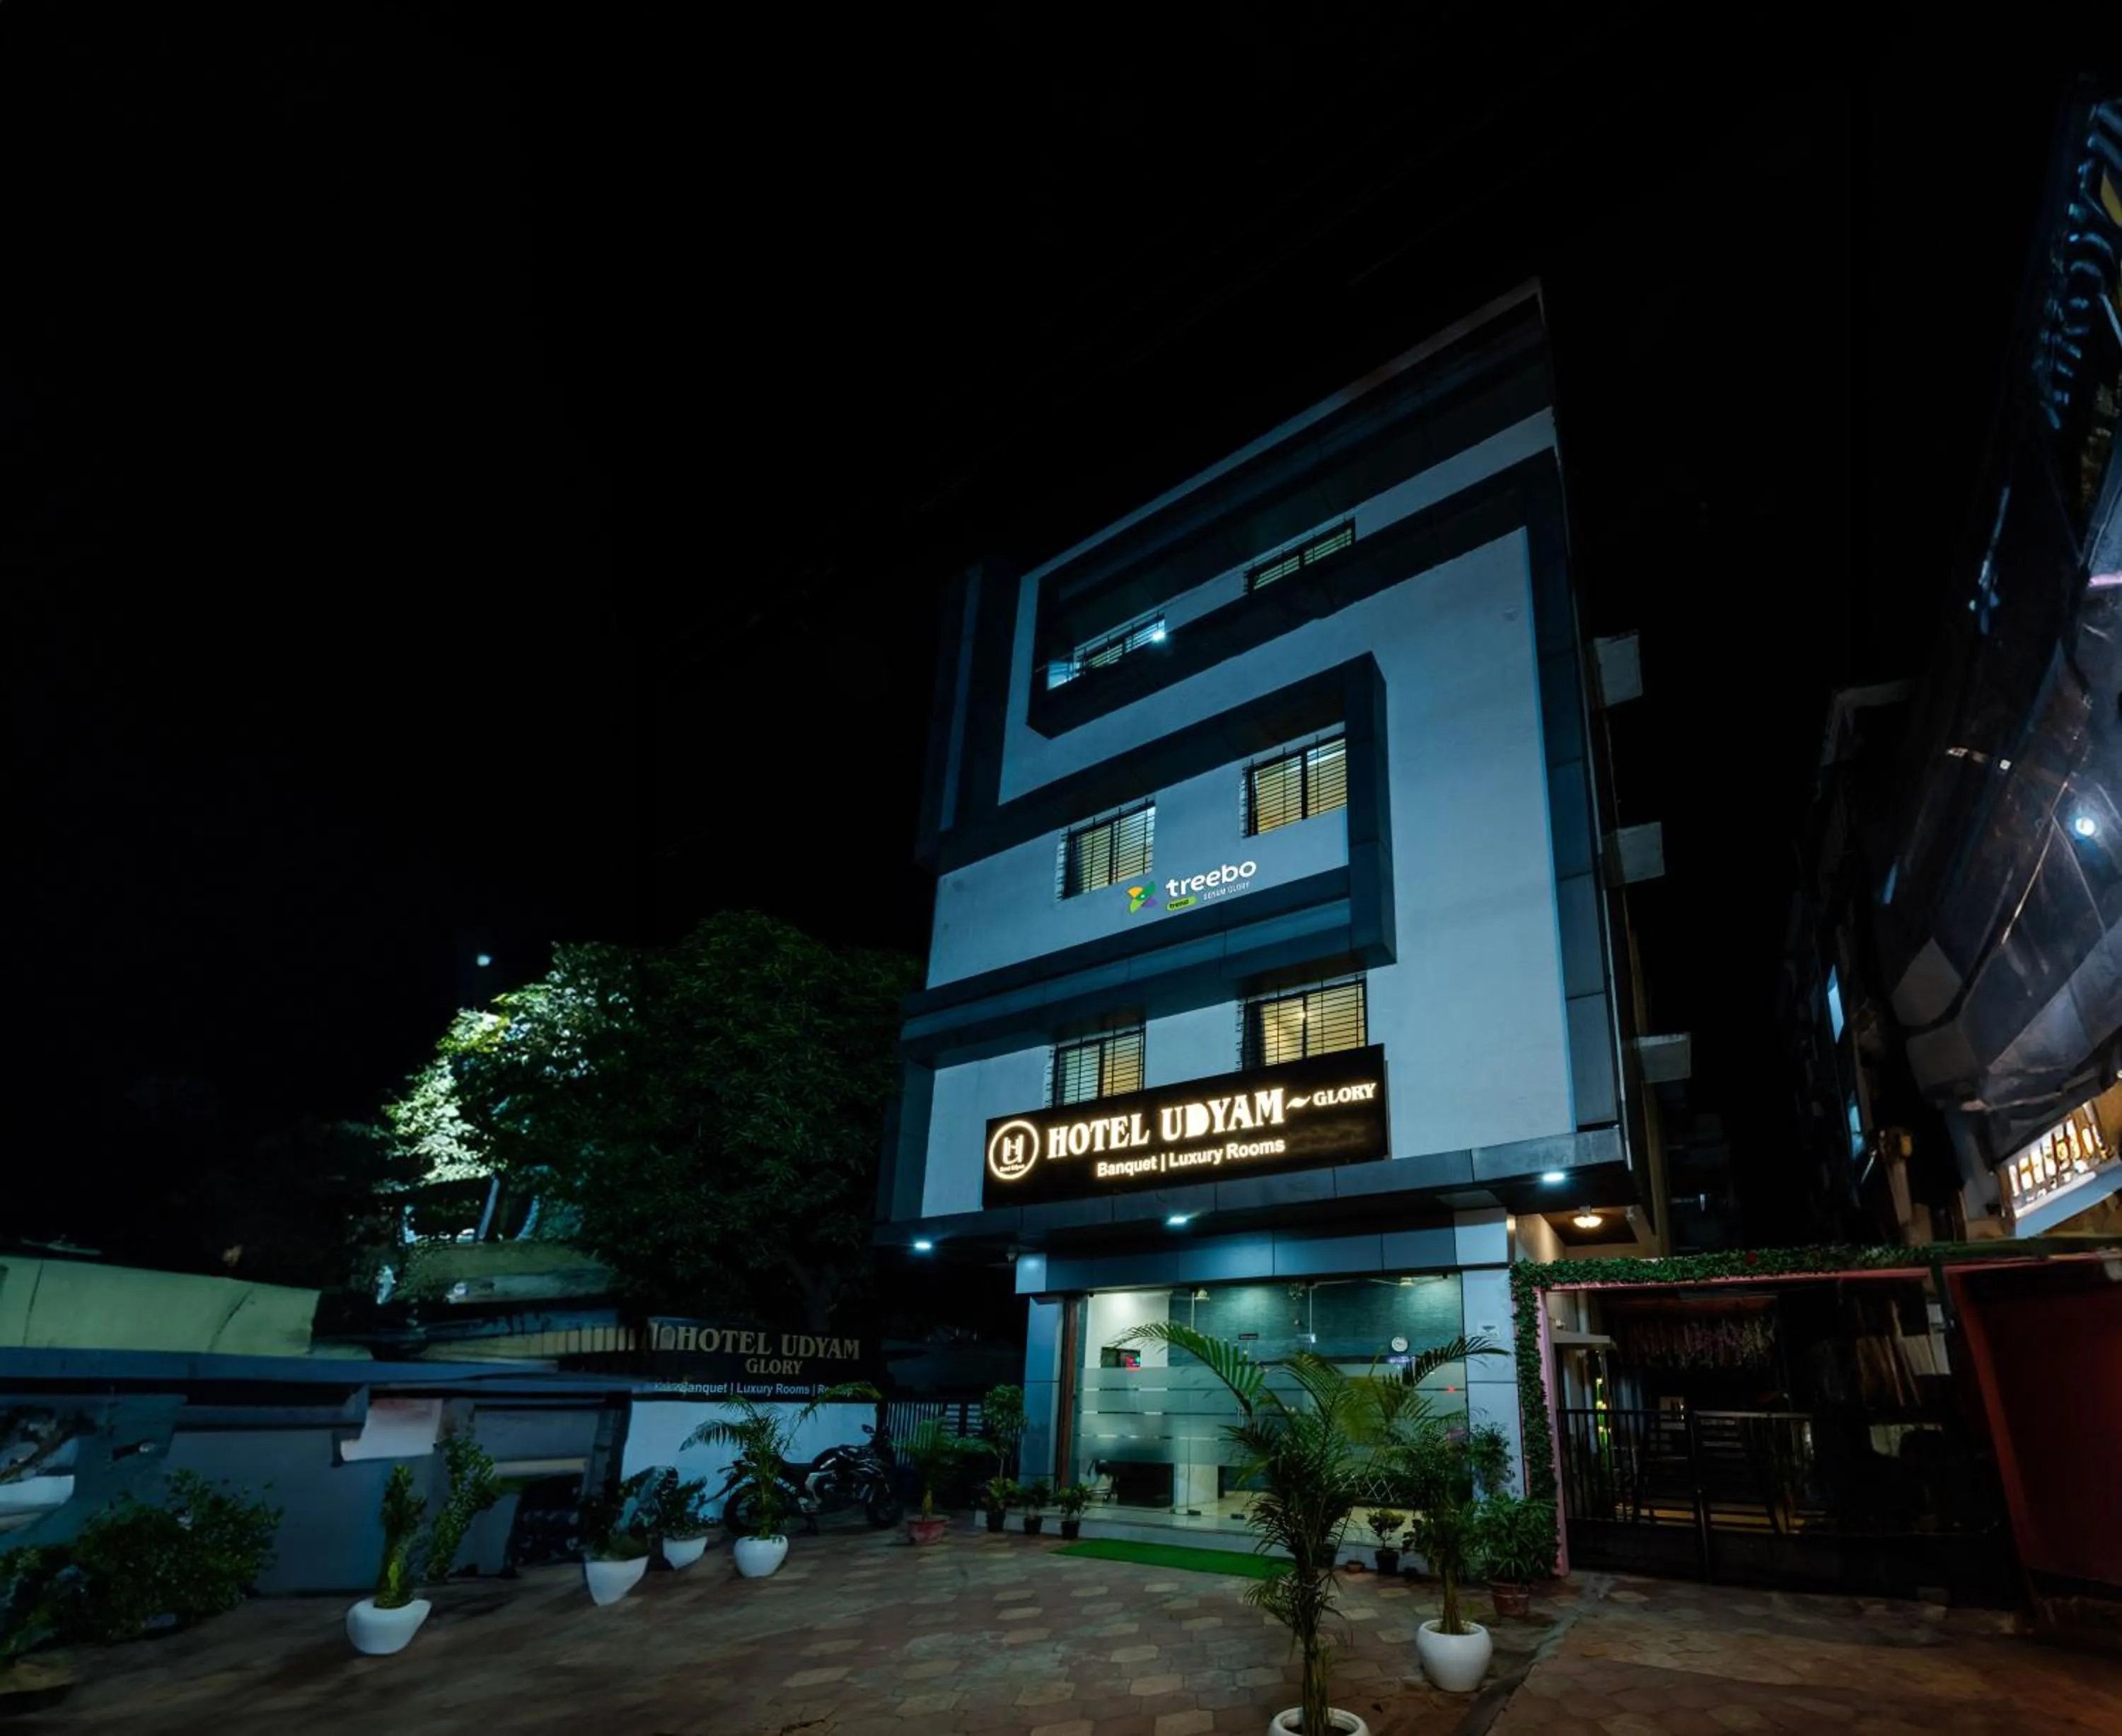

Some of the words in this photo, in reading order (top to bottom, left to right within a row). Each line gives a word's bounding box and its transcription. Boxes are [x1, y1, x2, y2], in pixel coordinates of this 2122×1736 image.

[1166, 861, 1257, 896] treebo
[1046, 1113, 1151, 1159] HOTEL
[1159, 1087, 1285, 1142] UDYAM
[1313, 1082, 1376, 1106] GLORY
[1097, 1155, 1158, 1178] Banquet
[1169, 1147, 1223, 1167] Luxury
[1226, 1139, 1286, 1160] Rooms
[677, 1326, 771, 1355] HOTEL
[780, 1333, 861, 1360] UDYAM
[745, 1358, 803, 1375] GLORY
[736, 1382, 773, 1396] Luxury
[775, 1383, 810, 1395] Rooms
